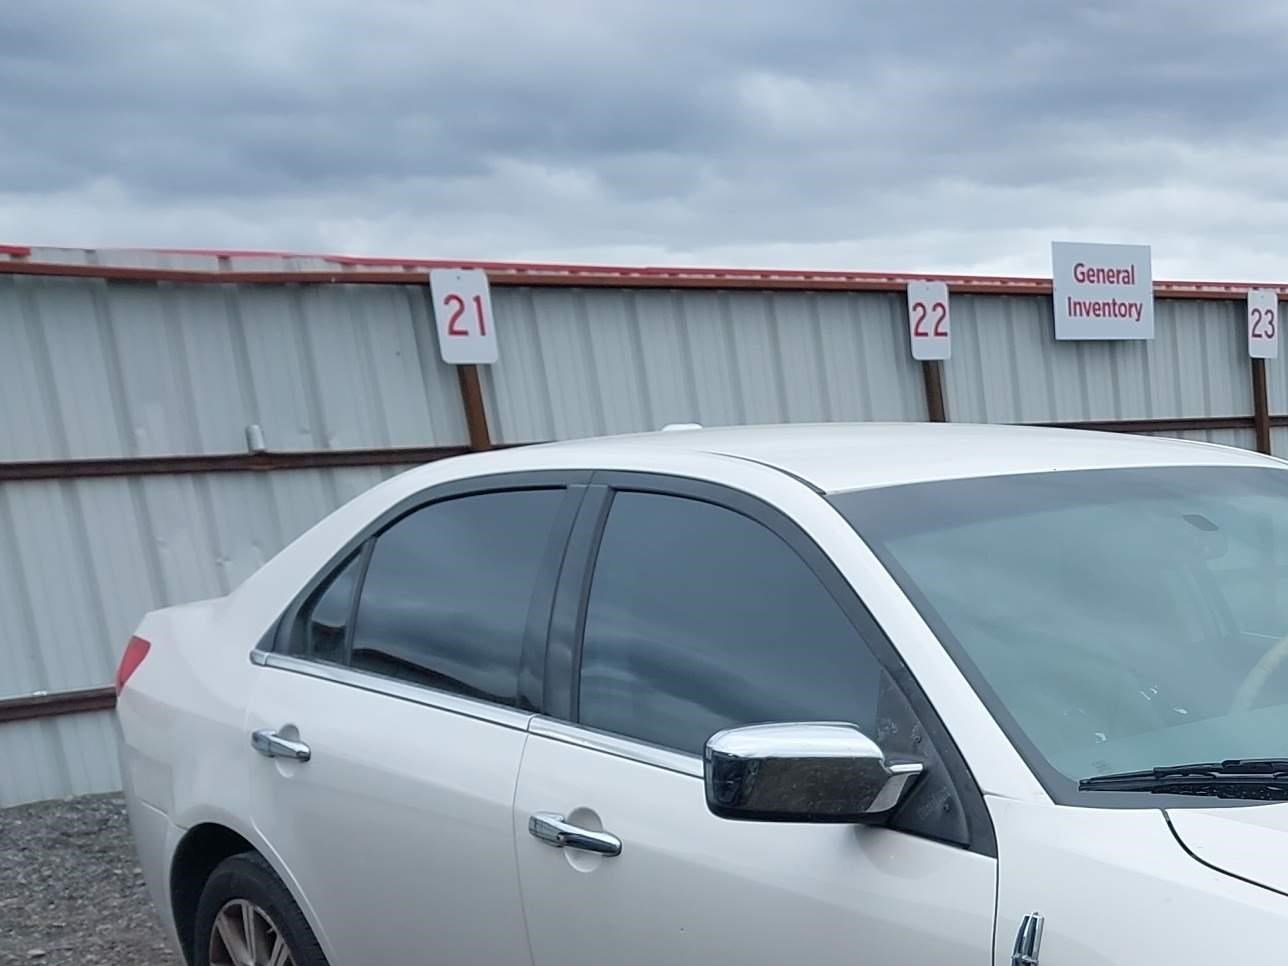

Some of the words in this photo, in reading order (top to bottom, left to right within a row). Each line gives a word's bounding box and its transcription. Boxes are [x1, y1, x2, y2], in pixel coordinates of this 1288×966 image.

[1073, 263, 1136, 285] General
[443, 294, 487, 337] 21
[912, 302, 948, 337] 22
[1067, 296, 1143, 322] Inventory
[1250, 308, 1276, 339] 23
